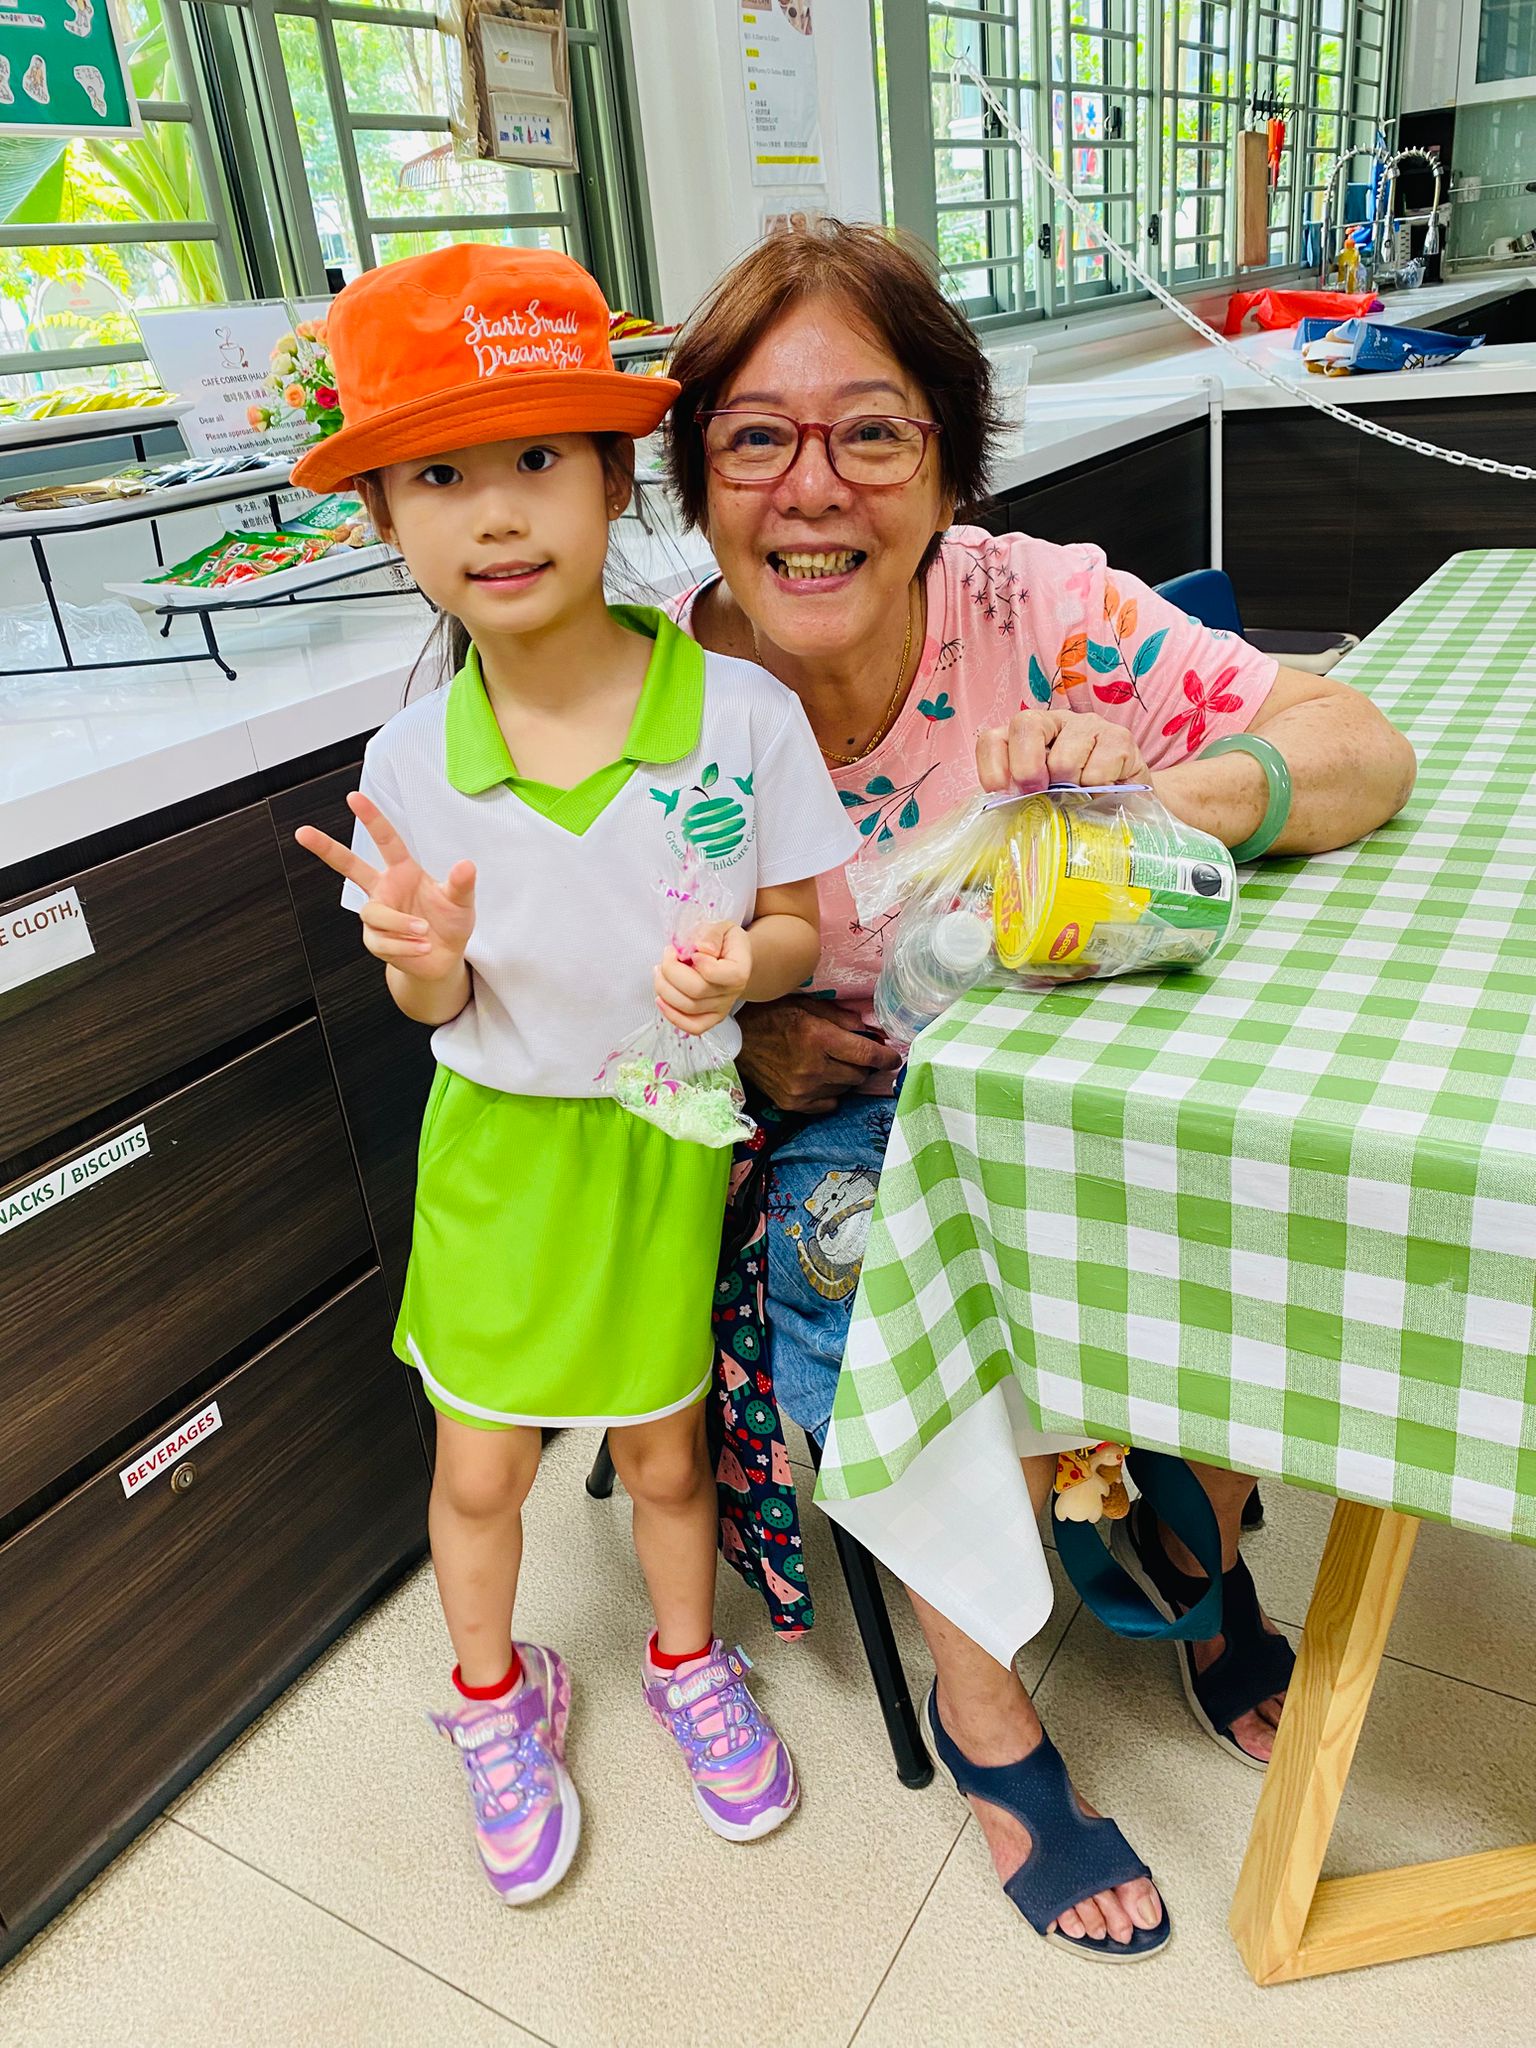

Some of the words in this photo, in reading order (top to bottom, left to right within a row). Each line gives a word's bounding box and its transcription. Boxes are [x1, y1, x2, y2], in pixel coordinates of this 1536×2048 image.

[461, 304, 526, 345] Start
[525, 298, 579, 337] Small
[473, 344, 550, 378] Dream
[547, 338, 585, 370] Big
[220, 373, 249, 385] CORNER
[199, 415, 215, 425] Dear
[215, 413, 225, 422] all
[205, 430, 229, 442] Please
[228, 426, 259, 438] approac
[211, 443, 239, 455] biscuits,
[12, 900, 79, 939] CLOTH,
[1051, 927, 1077, 961] Maggi
[60, 1172, 65, 1196] /
[71, 1131, 146, 1184] BISCUITS
[126, 1412, 215, 1488] BEVERAGES
